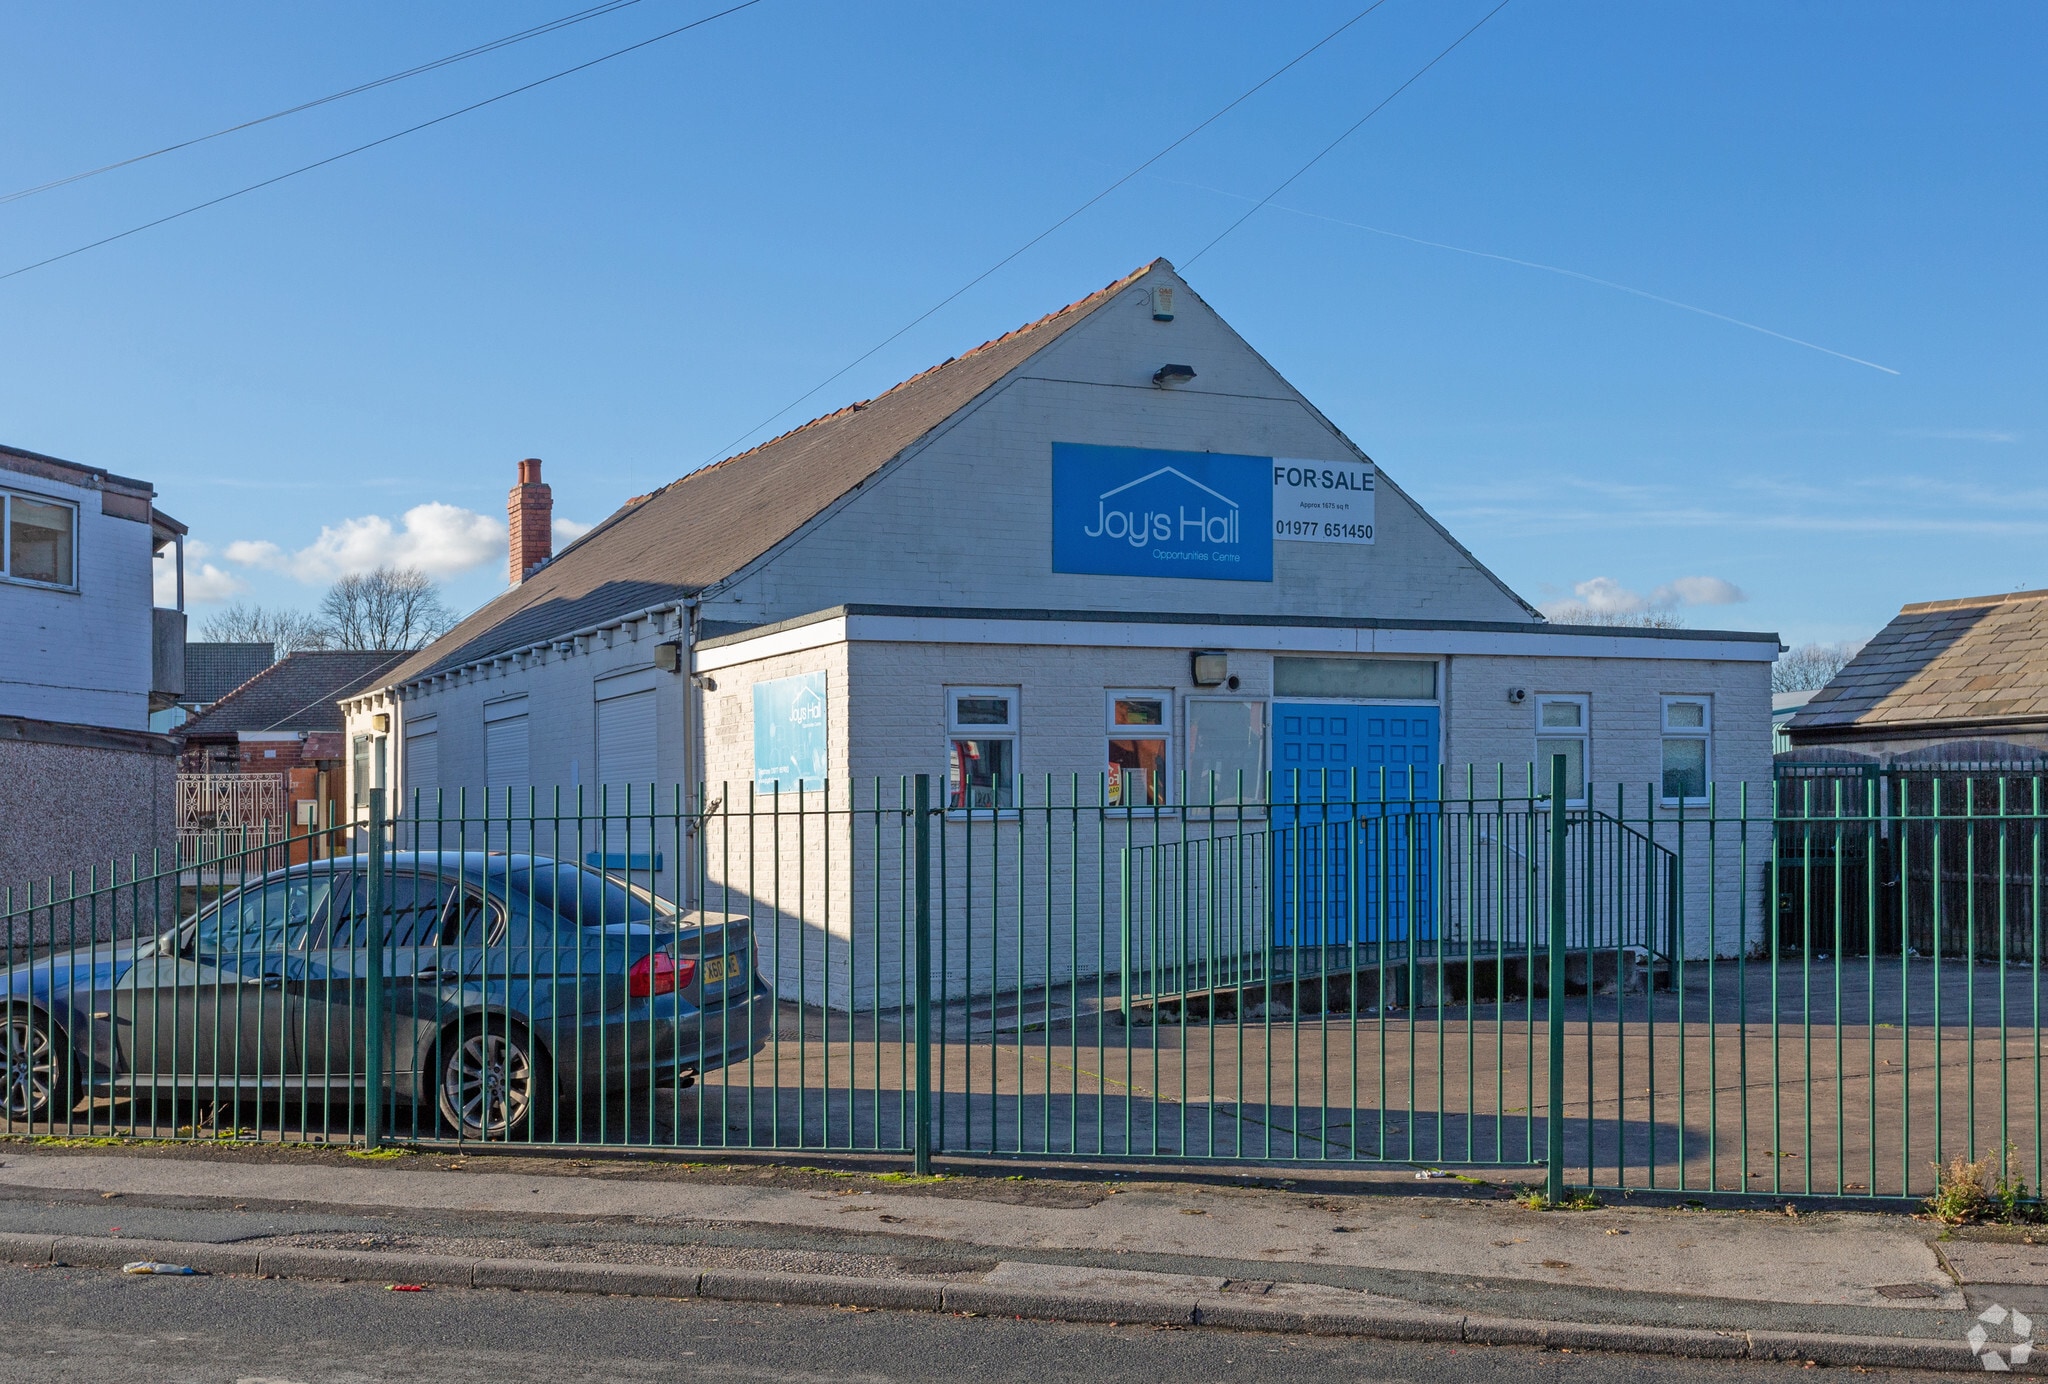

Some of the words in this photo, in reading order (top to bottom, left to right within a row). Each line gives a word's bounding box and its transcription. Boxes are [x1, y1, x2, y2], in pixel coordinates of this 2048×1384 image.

[1274, 466, 1317, 488] FOR
[1321, 469, 1375, 491] SALE
[1299, 501, 1320, 510] Approx
[1084, 501, 1171, 547] Joy's
[1179, 505, 1239, 544] Hall
[1276, 520, 1318, 536] 01977
[1324, 523, 1373, 539] 651450
[1152, 549, 1209, 561] Opportunities
[1212, 551, 1240, 562] Centre
